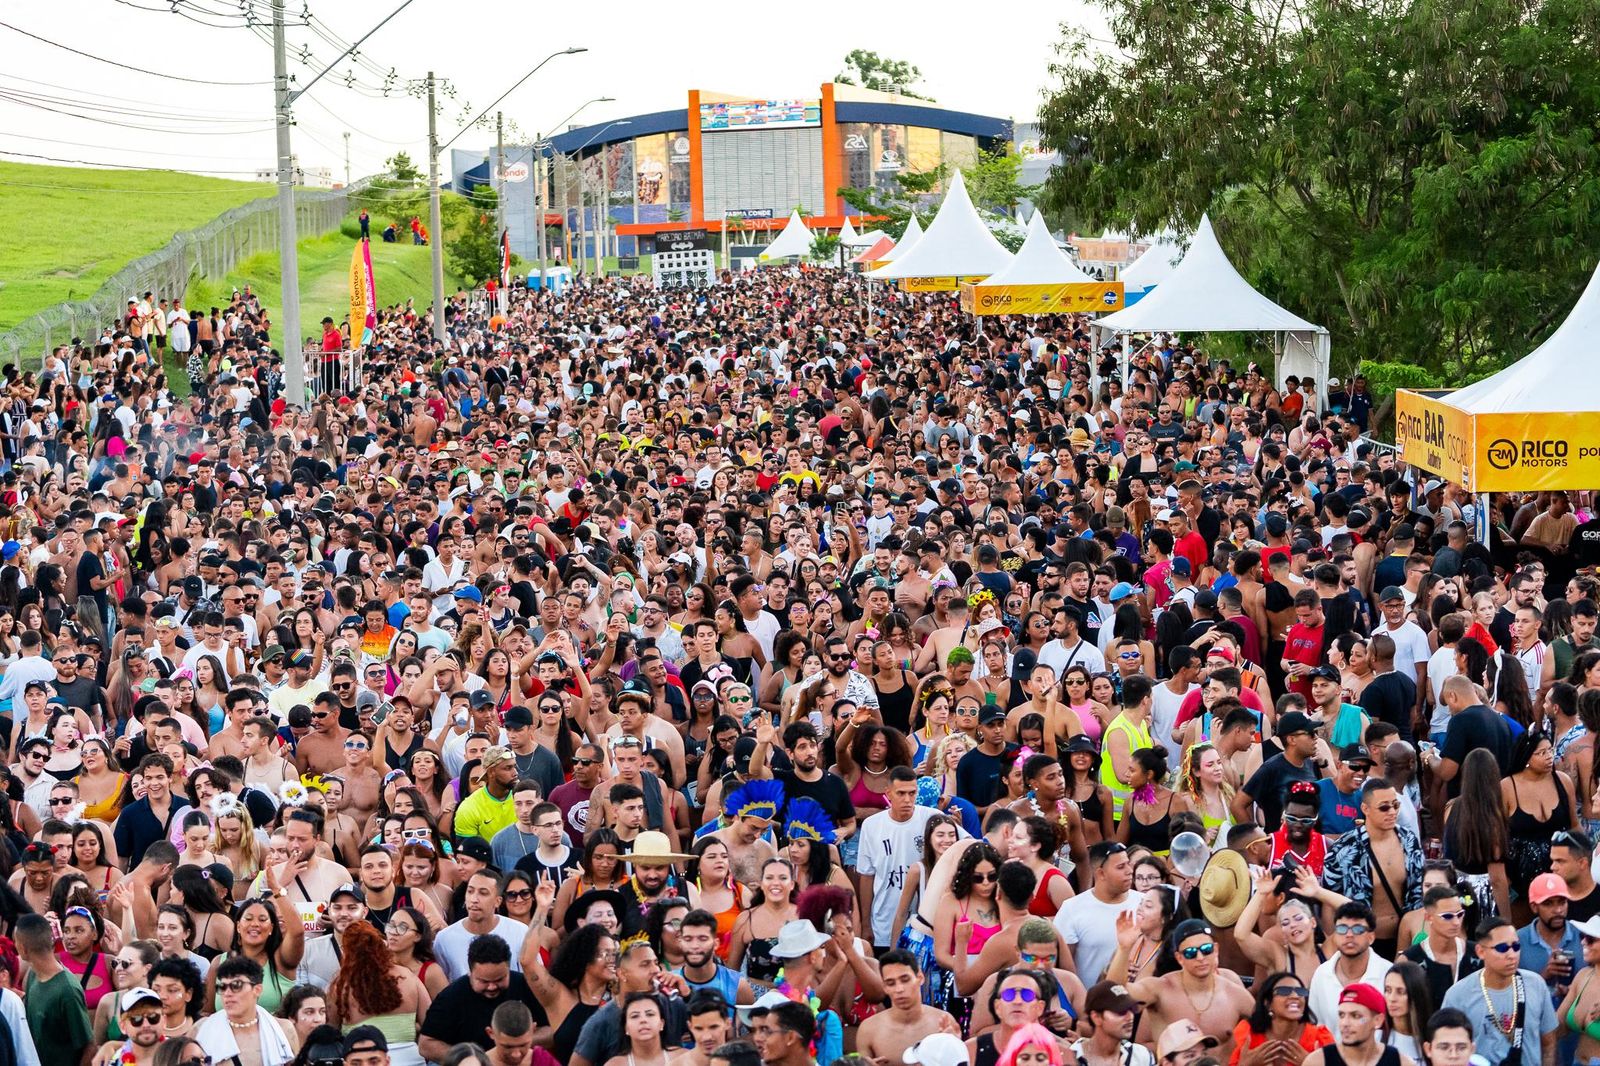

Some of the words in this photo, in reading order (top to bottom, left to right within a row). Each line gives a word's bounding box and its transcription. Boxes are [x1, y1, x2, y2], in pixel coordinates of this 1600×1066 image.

[994, 295, 1011, 303] RICO
[1424, 409, 1445, 449] BAR
[1521, 440, 1568, 458] RICO
[1521, 458, 1568, 467] MOTORS
